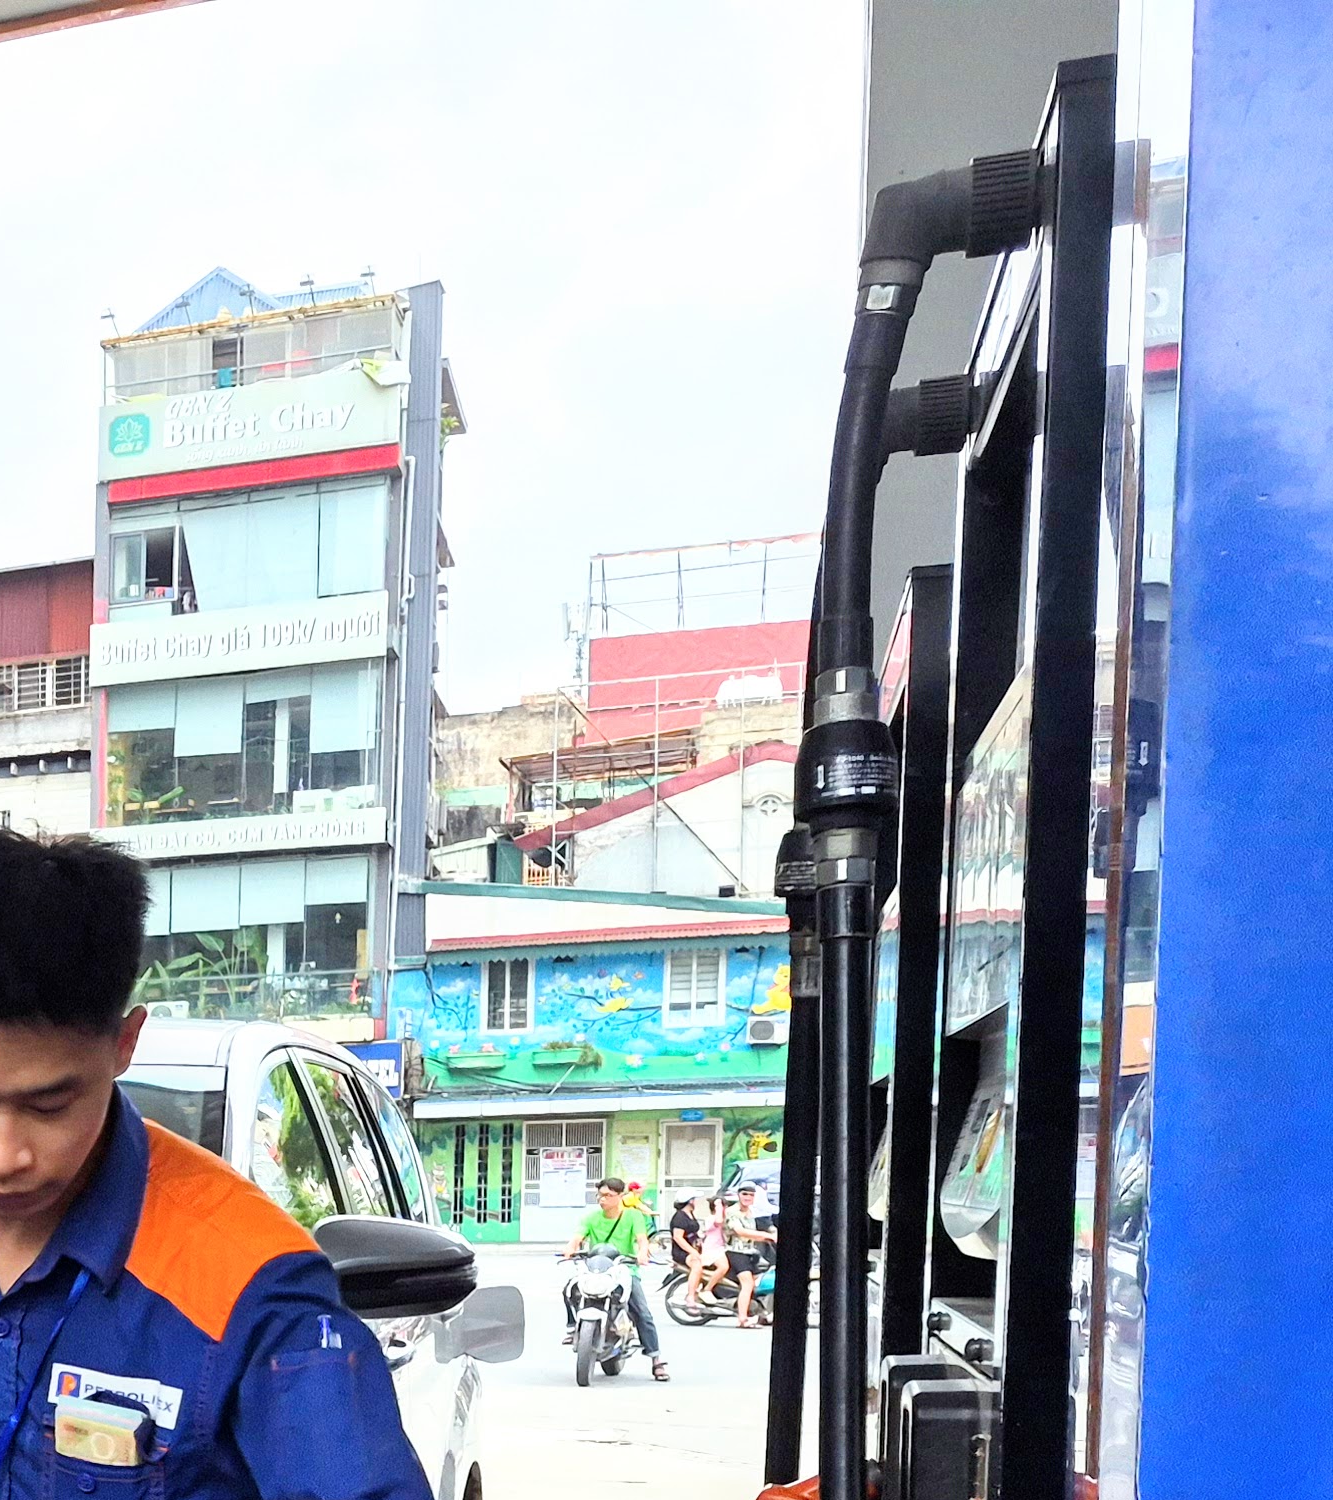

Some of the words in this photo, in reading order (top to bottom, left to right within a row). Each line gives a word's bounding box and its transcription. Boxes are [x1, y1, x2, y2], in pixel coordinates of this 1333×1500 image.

[163, 410, 261, 448] Buffet
[269, 402, 356, 432] Chay
[164, 632, 213, 660] Chay
